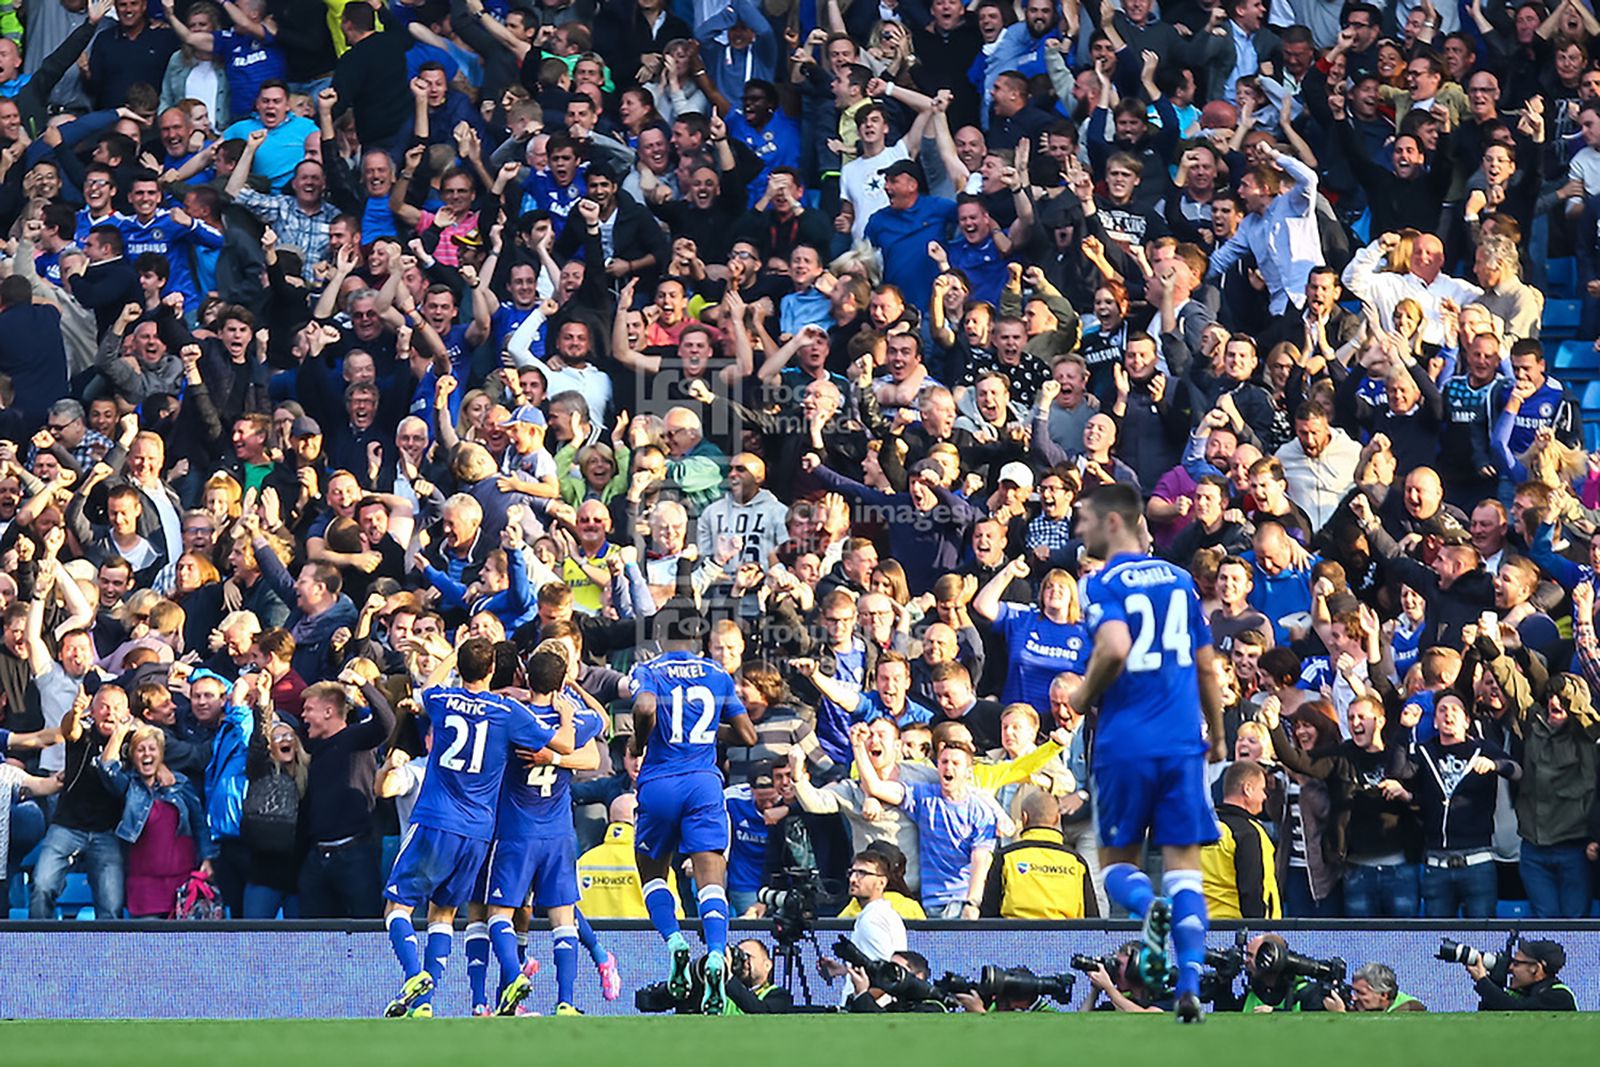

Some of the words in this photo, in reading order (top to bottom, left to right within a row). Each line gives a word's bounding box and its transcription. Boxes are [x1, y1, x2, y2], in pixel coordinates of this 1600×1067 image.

[1124, 588, 1194, 672] 24
[1025, 639, 1079, 662] SAMSUNG
[667, 664, 707, 679] MIKEL
[446, 697, 487, 716] MATIC
[668, 685, 717, 744] 12
[439, 714, 489, 774] 21
[527, 765, 558, 798] 4
[592, 876, 633, 886] SHOWSEC
[1029, 863, 1076, 876] SHOWSEC
